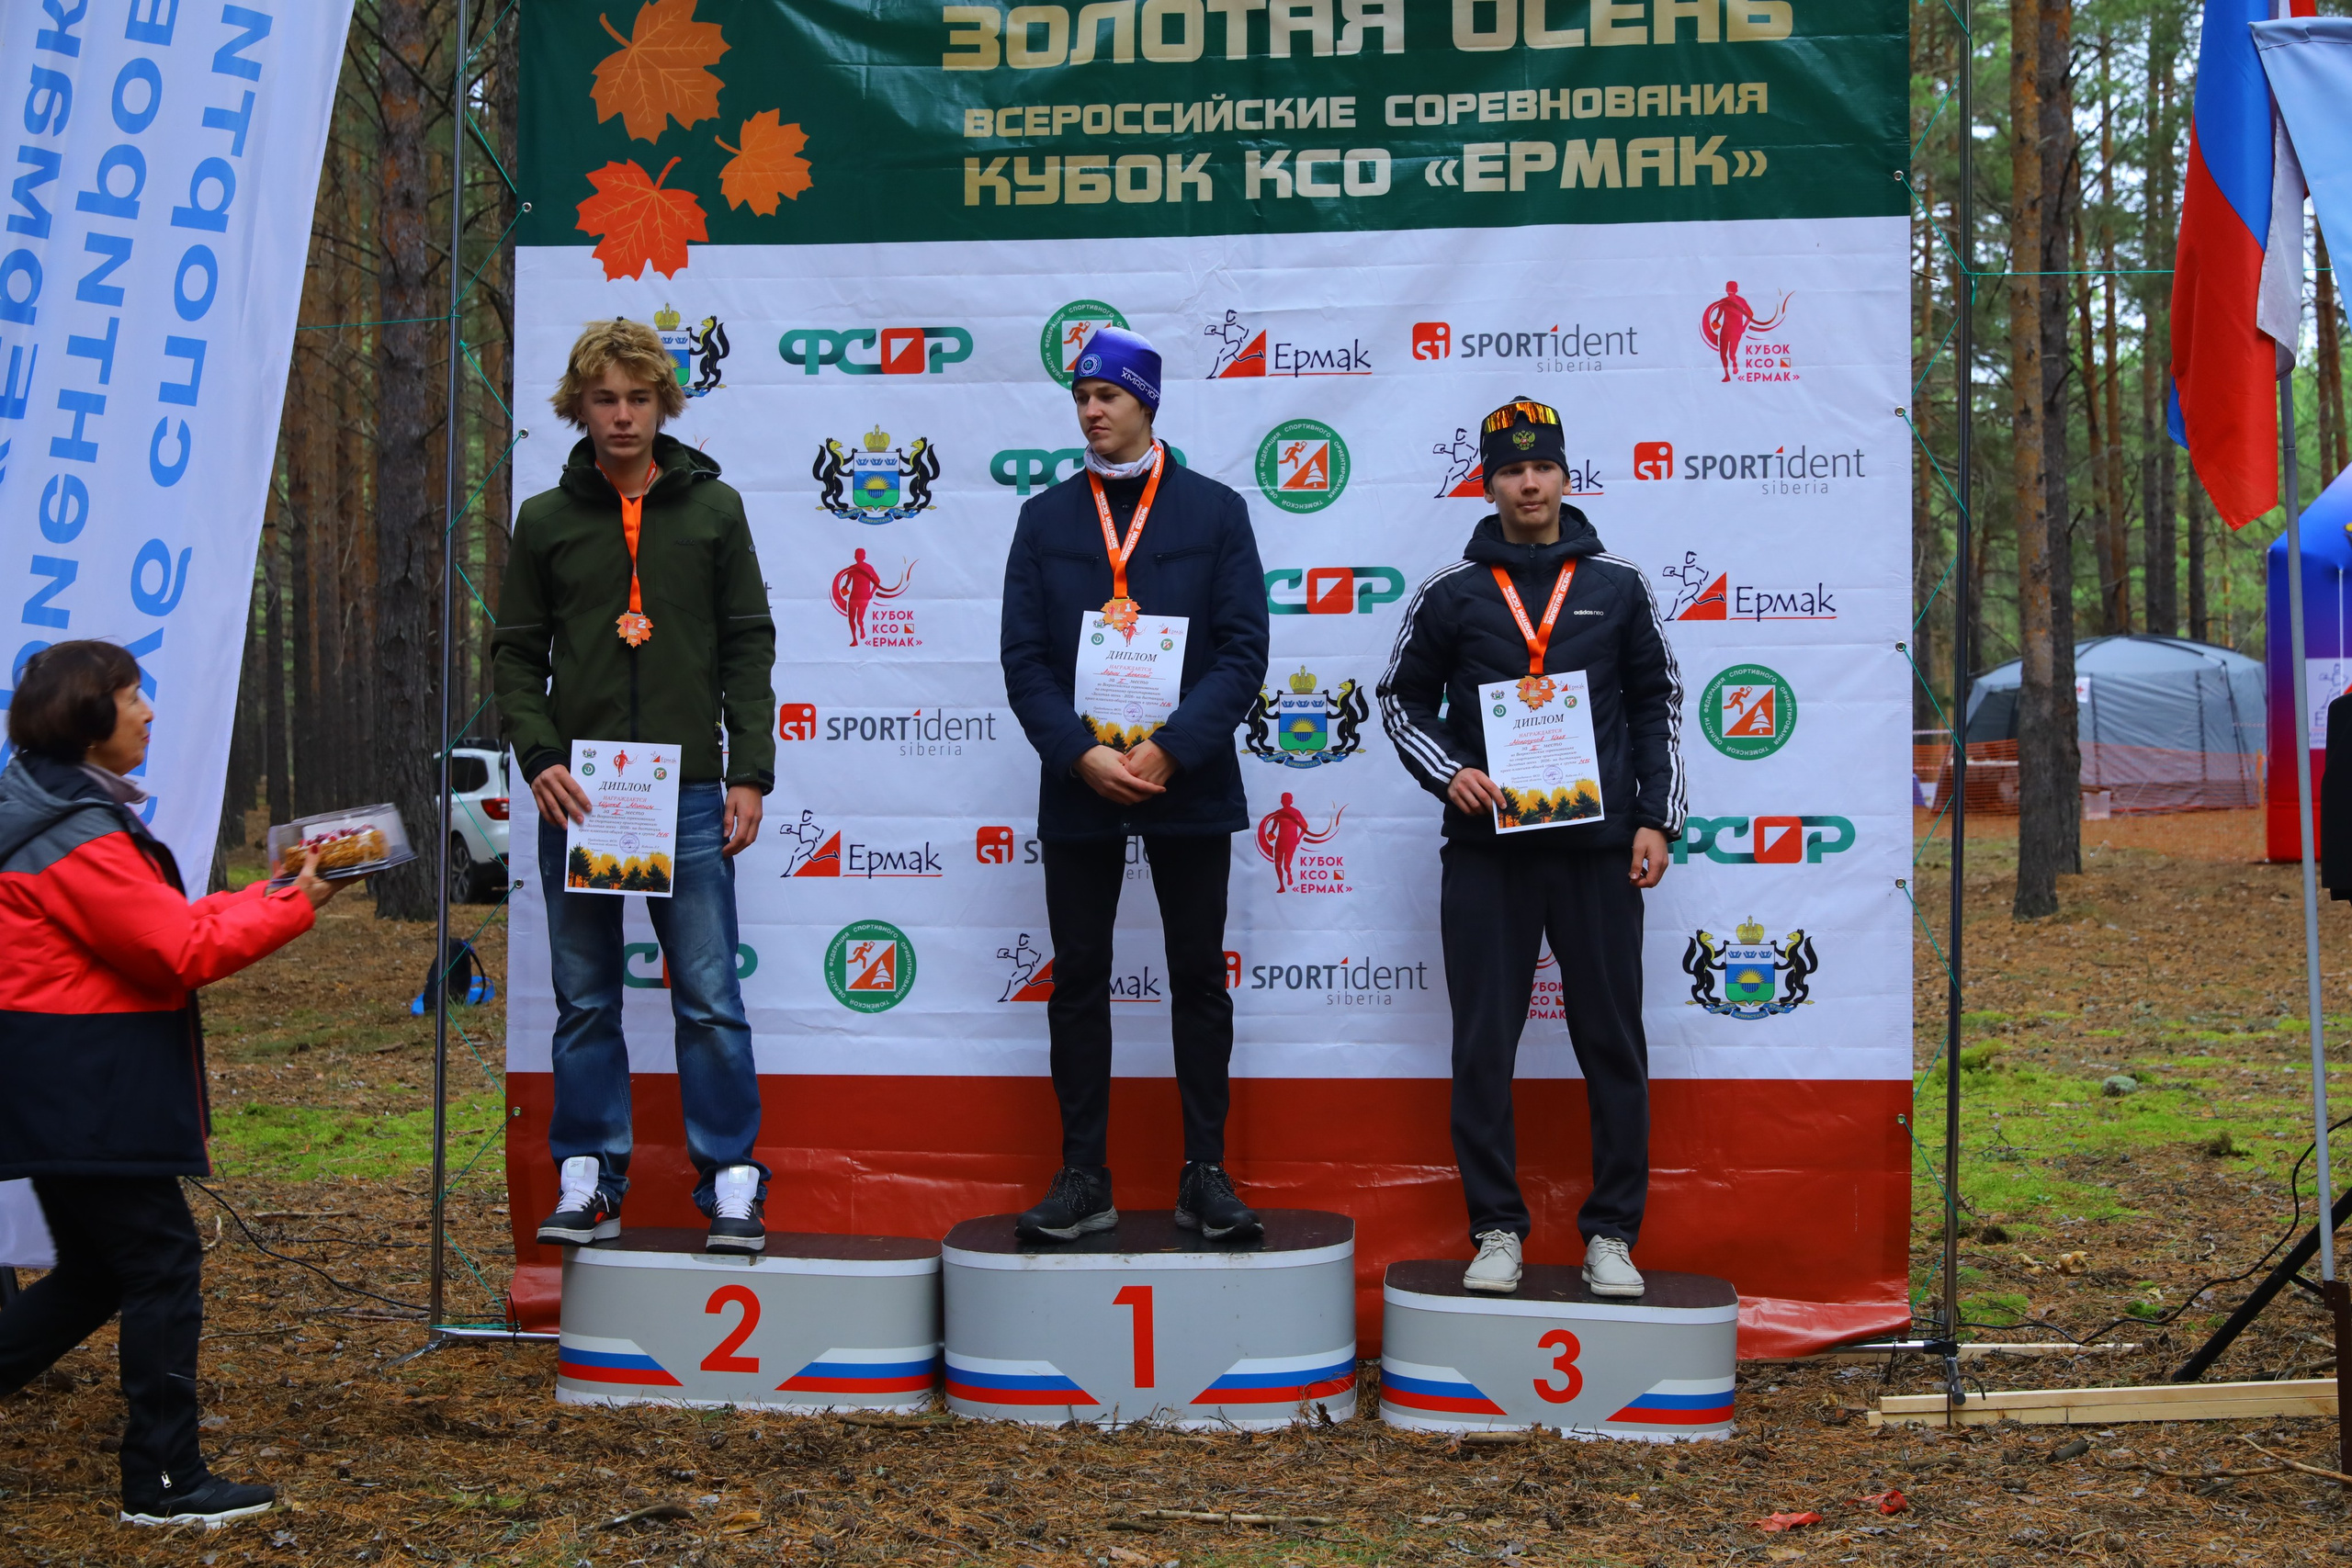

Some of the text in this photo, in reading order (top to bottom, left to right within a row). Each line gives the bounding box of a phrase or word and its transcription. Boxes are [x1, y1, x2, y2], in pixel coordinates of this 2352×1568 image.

[943, 0, 1404, 70] ЗОЛОТАЯ
[965, 83, 1767, 137] ВСЕРОССИЙСКИЕ СОРЕВНОВАНИЯ
[965, 136, 1767, 205] КУБОК КСО «ЕРМАК»
[1069, 303, 1114, 319] СПОРТИВНОГО
[1462, 324, 1638, 358] SPORTident
[1747, 344, 1790, 355] КУБОК
[1274, 339, 1373, 376] Ермак
[1537, 357, 1601, 372] siberia
[1746, 358, 1774, 367] КСО
[1046, 352, 1064, 379] ОБЛАСТИ
[1738, 372, 1800, 382] «ЕРМАК»
[1261, 423, 1346, 509] ФЕДЕРАЦИЯ СПОРТИВНОГО ОРИЕНТИРОВАНИЯ ТЮМЕНСКОЙ ОБЛАСТИ
[1685, 446, 1865, 479] SPORTident
[1762, 479, 1827, 494] siberia
[1125, 604, 1131, 612] 1
[1736, 583, 1836, 620] Ермак
[873, 611, 913, 620] КУБОК
[638, 619, 646, 629] 2
[873, 625, 899, 633] КСО
[865, 637, 922, 647] «ЕРМАК»
[1105, 650, 1158, 662] ДИПЛОМ
[1539, 680, 1549, 689] 3
[1703, 669, 1792, 755] ФЕДЕРАЦИЯ СПОРТИВНОГО ОРИЕНТИРОВАНИЯ ТЮМЕНСКОЙ ОБЛАСТИ
[827, 708, 996, 741] SPORTident
[1512, 714, 1564, 729] ДИПЛОМ
[900, 742, 961, 756] siberia
[599, 781, 652, 792] ДИПЛОМ
[849, 841, 942, 879] Ермак
[1300, 857, 1342, 866] КУБОК
[1301, 870, 1328, 880] КСО
[1293, 883, 1352, 893] «ЕРМАК»
[829, 924, 912, 1009] ФЕДЕРАЦИЯ СПОРТИВНОГО ОРИЕНТИРОВАНИЯ ТЮМЕНСКОЙ ОБЛАСТИ
[1251, 955, 1430, 991] SPORTident
[1328, 991, 1393, 1005] siberia
[701, 1284, 761, 1373] 2
[1113, 1286, 1154, 1388] 1
[1533, 1329, 1583, 1404] 3
